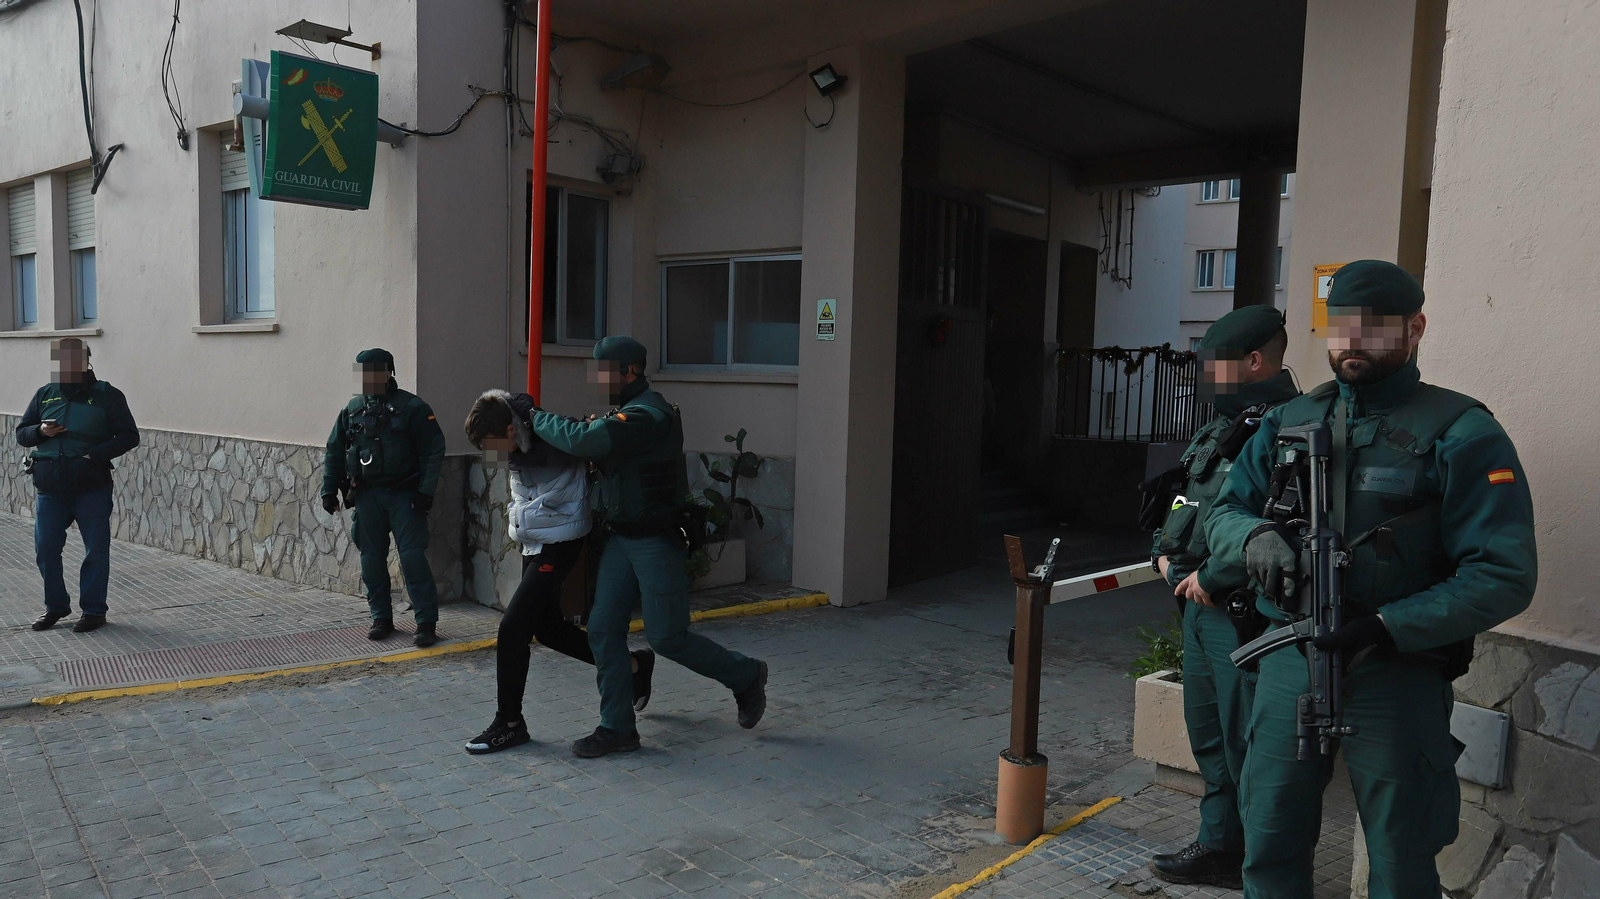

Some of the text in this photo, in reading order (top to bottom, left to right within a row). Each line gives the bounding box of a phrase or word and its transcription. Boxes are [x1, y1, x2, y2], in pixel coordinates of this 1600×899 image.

[274, 170, 362, 193] GUARDIA CIVIL
[491, 731, 516, 747] Calvin
